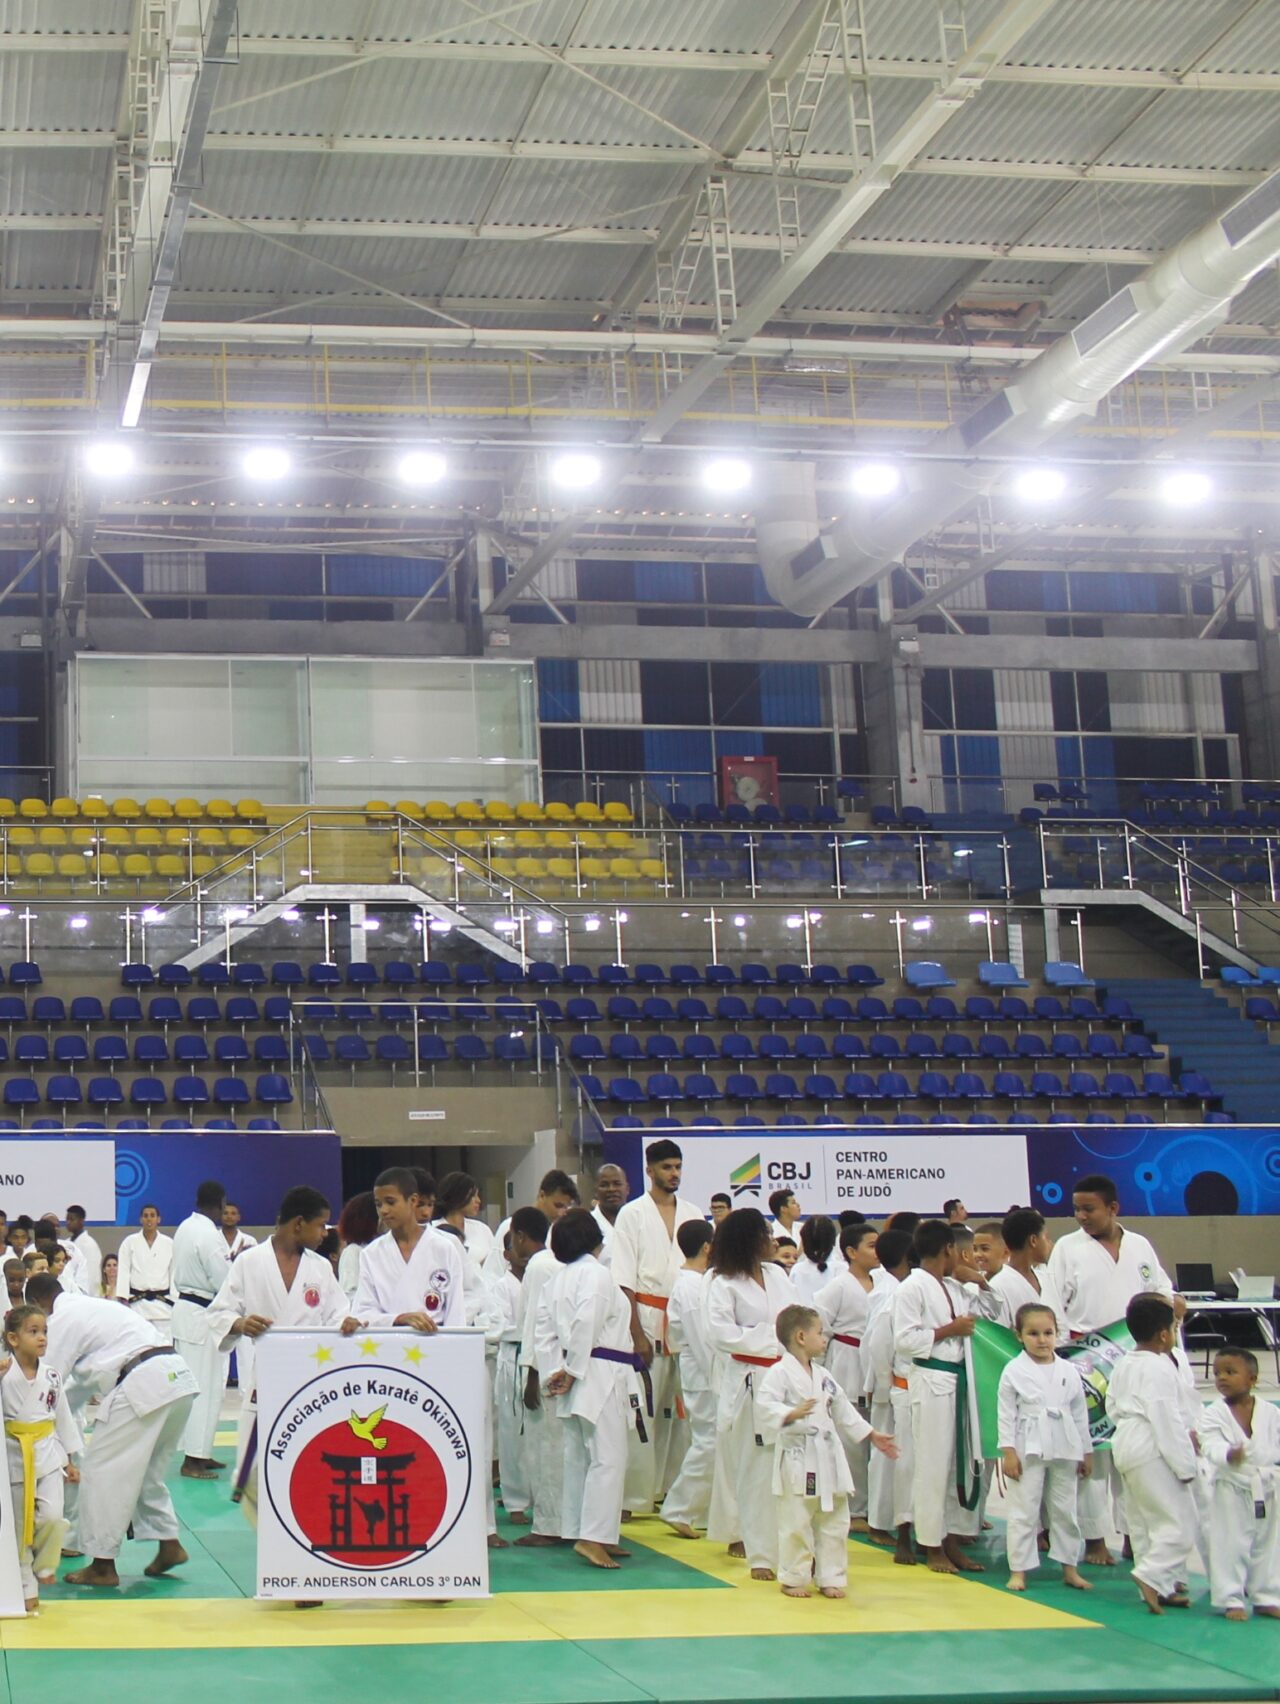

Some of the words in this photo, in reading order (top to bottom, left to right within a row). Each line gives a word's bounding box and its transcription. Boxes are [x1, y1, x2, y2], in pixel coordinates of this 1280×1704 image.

[836, 1151, 888, 1163] CENTRO
[767, 1162, 811, 1180] CBJ
[836, 1168, 946, 1180] PAN-AMERICANO
[768, 1182, 812, 1190] BRASIL
[837, 1186, 855, 1197] DE
[858, 1183, 892, 1197] JUDÔ
[270, 1388, 339, 1460] Associação
[342, 1382, 362, 1397] de
[367, 1380, 419, 1405] Karatê
[421, 1398, 467, 1460] Okinawa
[262, 1577, 301, 1588] PROF.
[304, 1576, 376, 1588] ANDERSON
[380, 1576, 435, 1588] CARLOS
[453, 1576, 481, 1587] DAN
